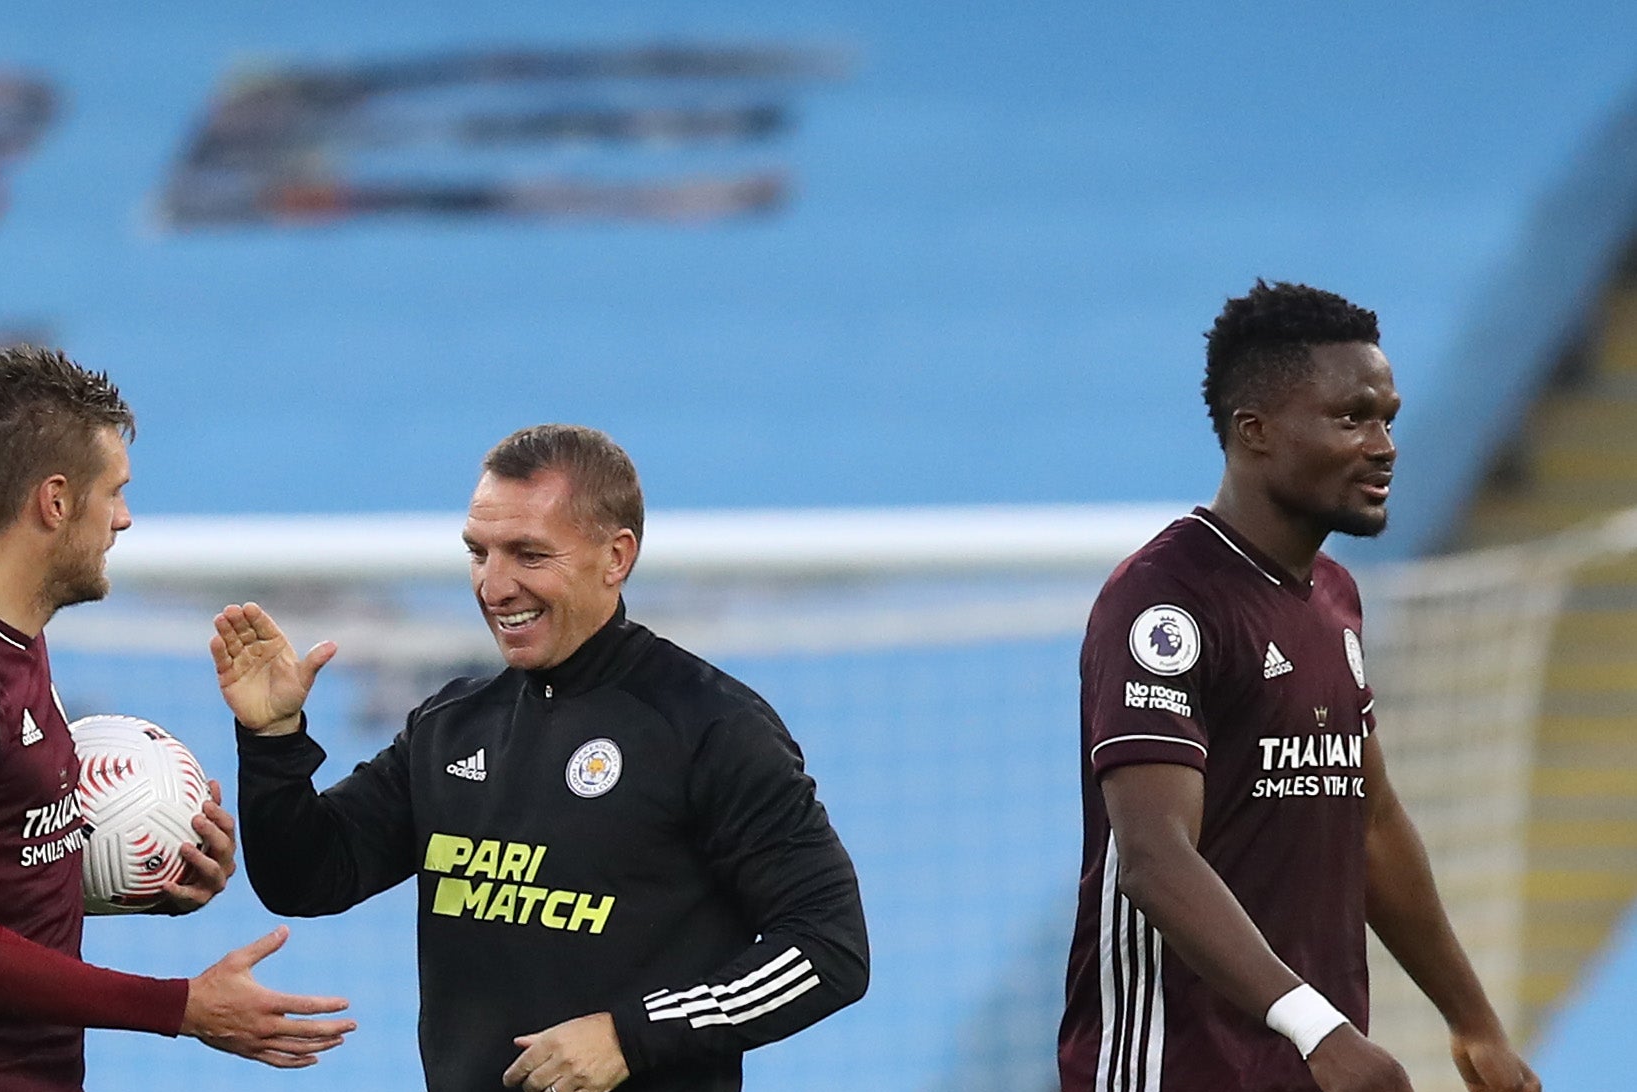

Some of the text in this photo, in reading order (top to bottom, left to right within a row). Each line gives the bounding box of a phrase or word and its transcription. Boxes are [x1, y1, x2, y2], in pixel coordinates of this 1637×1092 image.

[446, 763, 487, 782] adidas
[424, 833, 547, 883] PARI
[432, 876, 615, 934] MATCH
